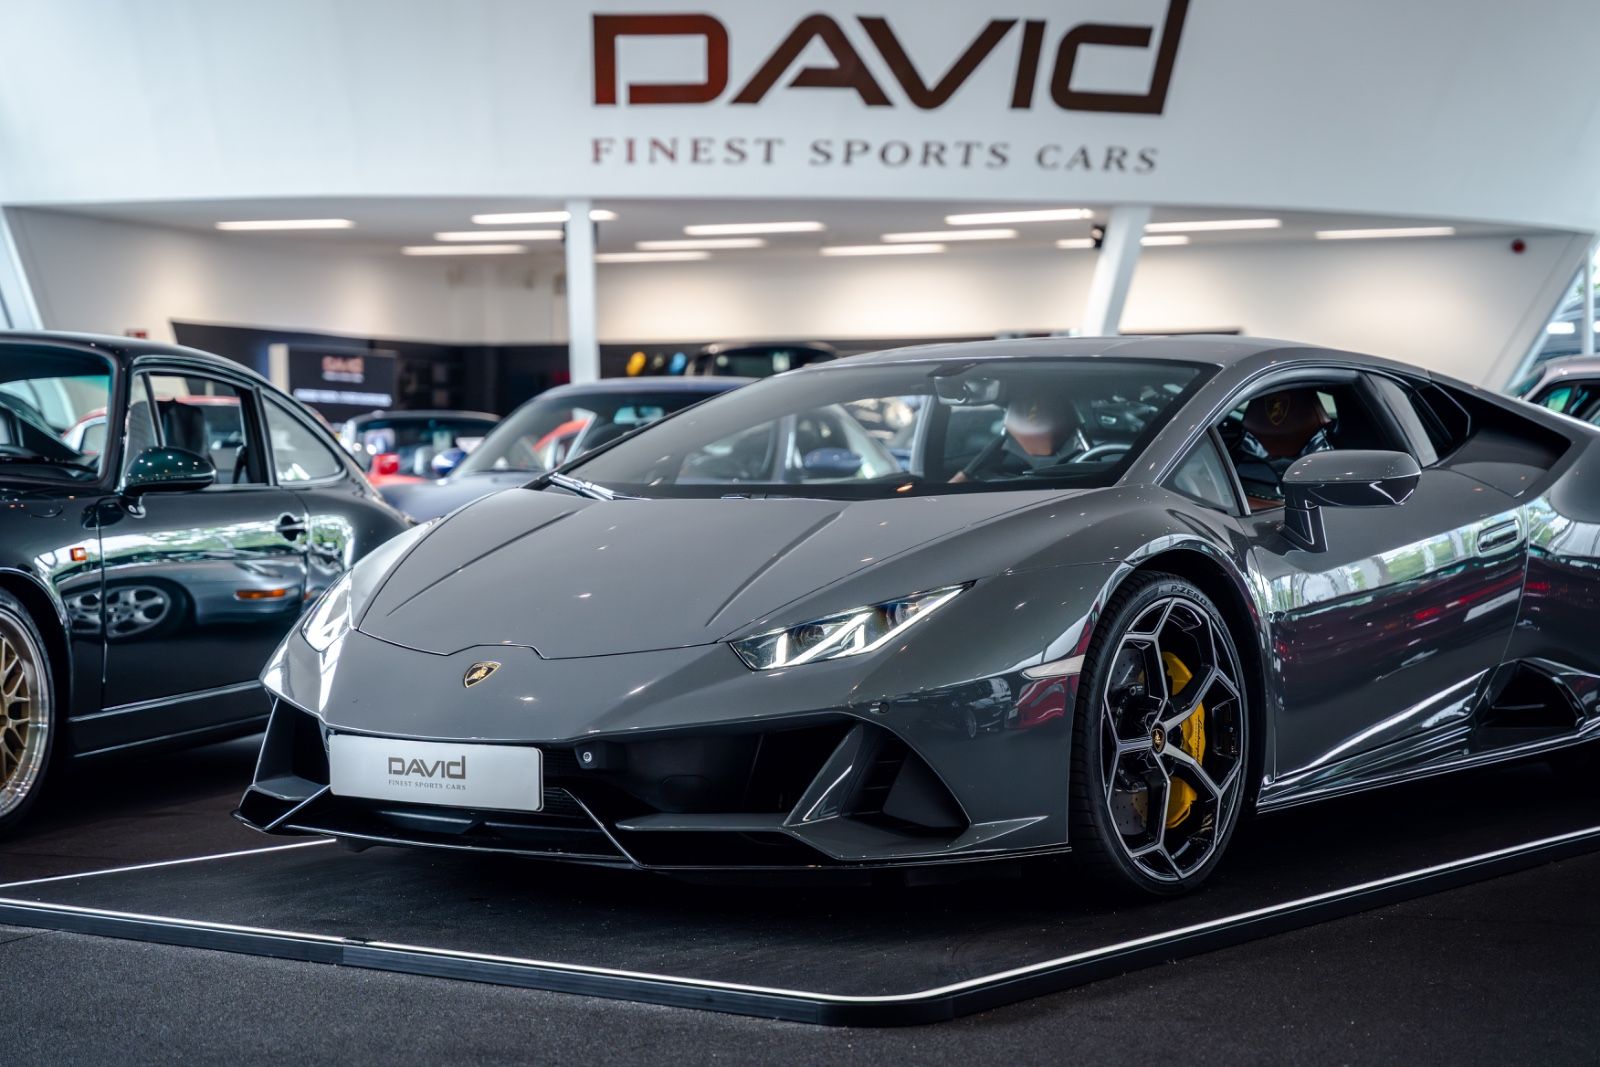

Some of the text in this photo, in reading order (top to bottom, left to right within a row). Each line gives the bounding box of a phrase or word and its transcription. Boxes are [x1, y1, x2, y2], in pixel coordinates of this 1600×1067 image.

[591, 138, 1159, 174] FINEST SPORTS CARS
[388, 779, 466, 791] FINEST SPORTS CARS
